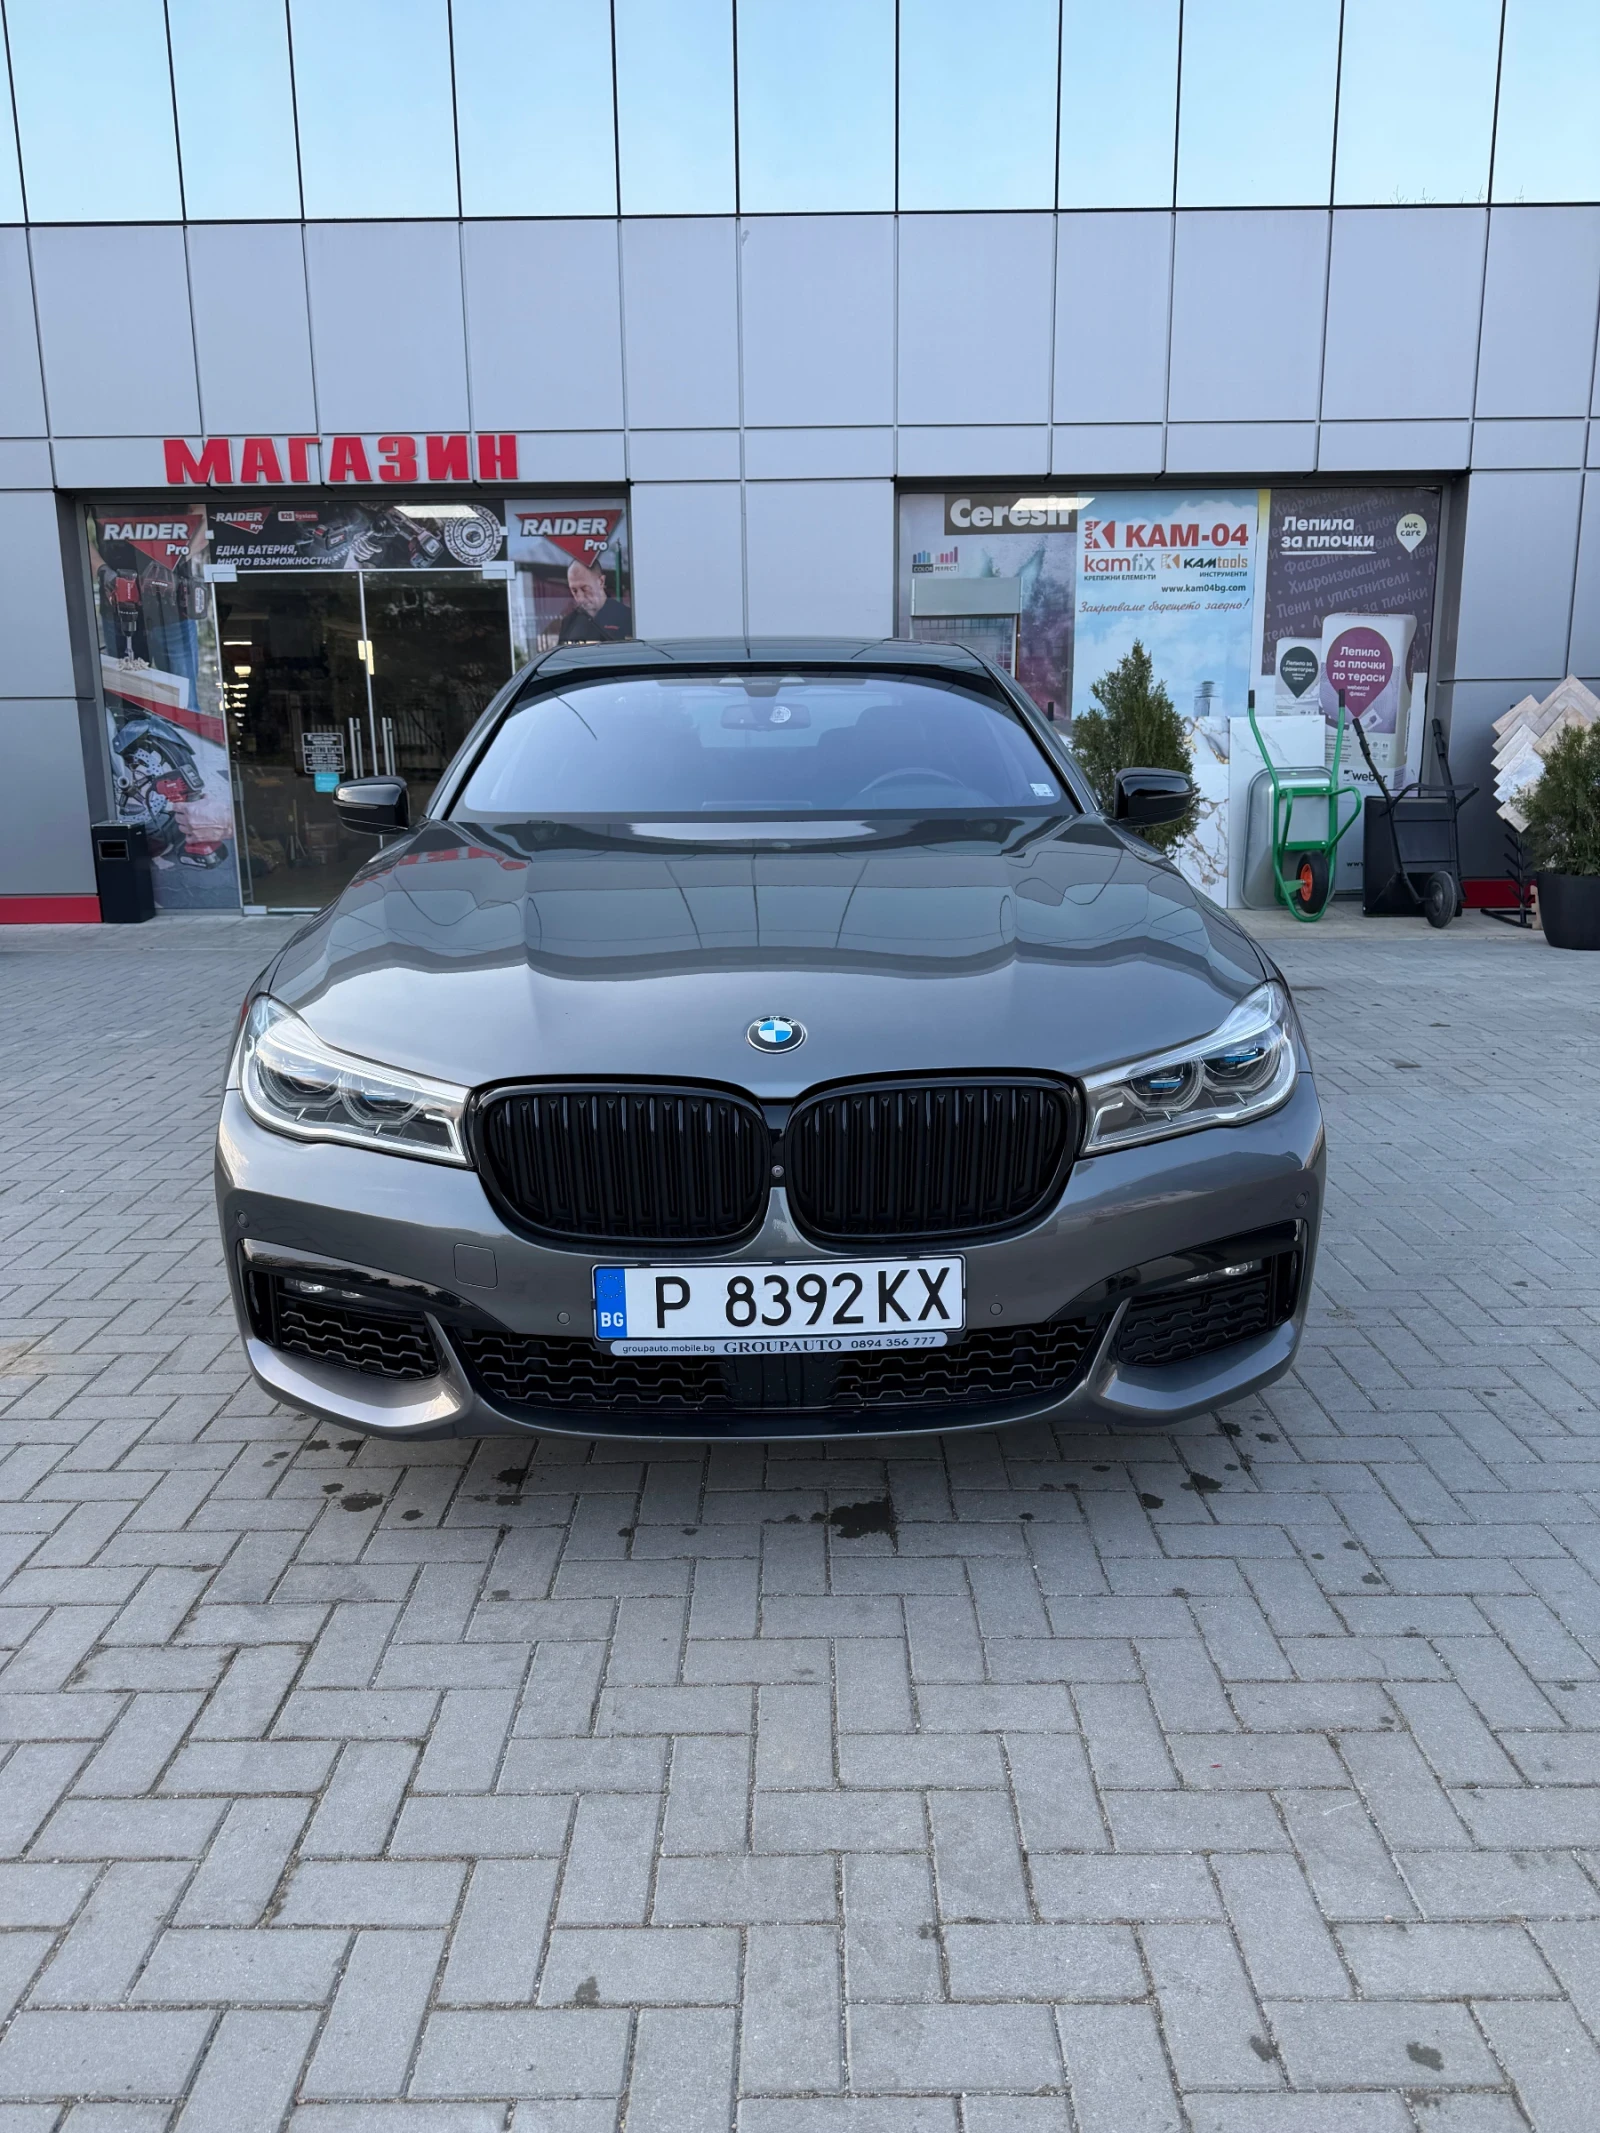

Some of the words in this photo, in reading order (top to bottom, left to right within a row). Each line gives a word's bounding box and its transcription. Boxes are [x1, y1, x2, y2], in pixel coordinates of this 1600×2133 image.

[163, 436, 518, 484] МАГАЗИН
[216, 512, 263, 522] RAIDER
[950, 495, 1072, 528] Ceresit
[250, 523, 263, 531] Pro
[521, 517, 608, 536] RAIDER
[1282, 515, 1355, 532] Лепила
[103, 523, 189, 541] RAIDER
[583, 539, 608, 551] Pro
[1280, 535, 1303, 548] за
[1306, 534, 1375, 548] плочки
[166, 543, 190, 556] Pro
[216, 545, 245, 557] ЕДНА
[247, 544, 298, 556] БАТЕРИЯ,
[216, 557, 252, 566] МНОГО
[1084, 554, 1156, 573] kamfix
[1288, 557, 1391, 595] Хидроизолации
[1161, 583, 1246, 595] www.kam04bg.com
[1276, 600, 1311, 618] Пени
[1315, 596, 1324, 608] и
[1328, 572, 1410, 608] уплътнители
[1382, 587, 1428, 609] плочки
[1079, 601, 1145, 615] Закрепваме
[1204, 598, 1250, 613] заедно!
[1340, 646, 1381, 657] Лепило
[1333, 659, 1346, 668] за
[1347, 660, 1386, 670] плочки
[1332, 672, 1346, 680] по
[1347, 672, 1386, 684] тераси
[655, 1276, 691, 1329] P
[600, 1314, 624, 1328] BG
[621, 1342, 716, 1354] groupauto.mobile.bg
[723, 1338, 842, 1353] GROUPAUTO
[850, 1339, 884, 1349] 0894
[886, 1337, 910, 1347] 356
[913, 1336, 936, 1346] 777
